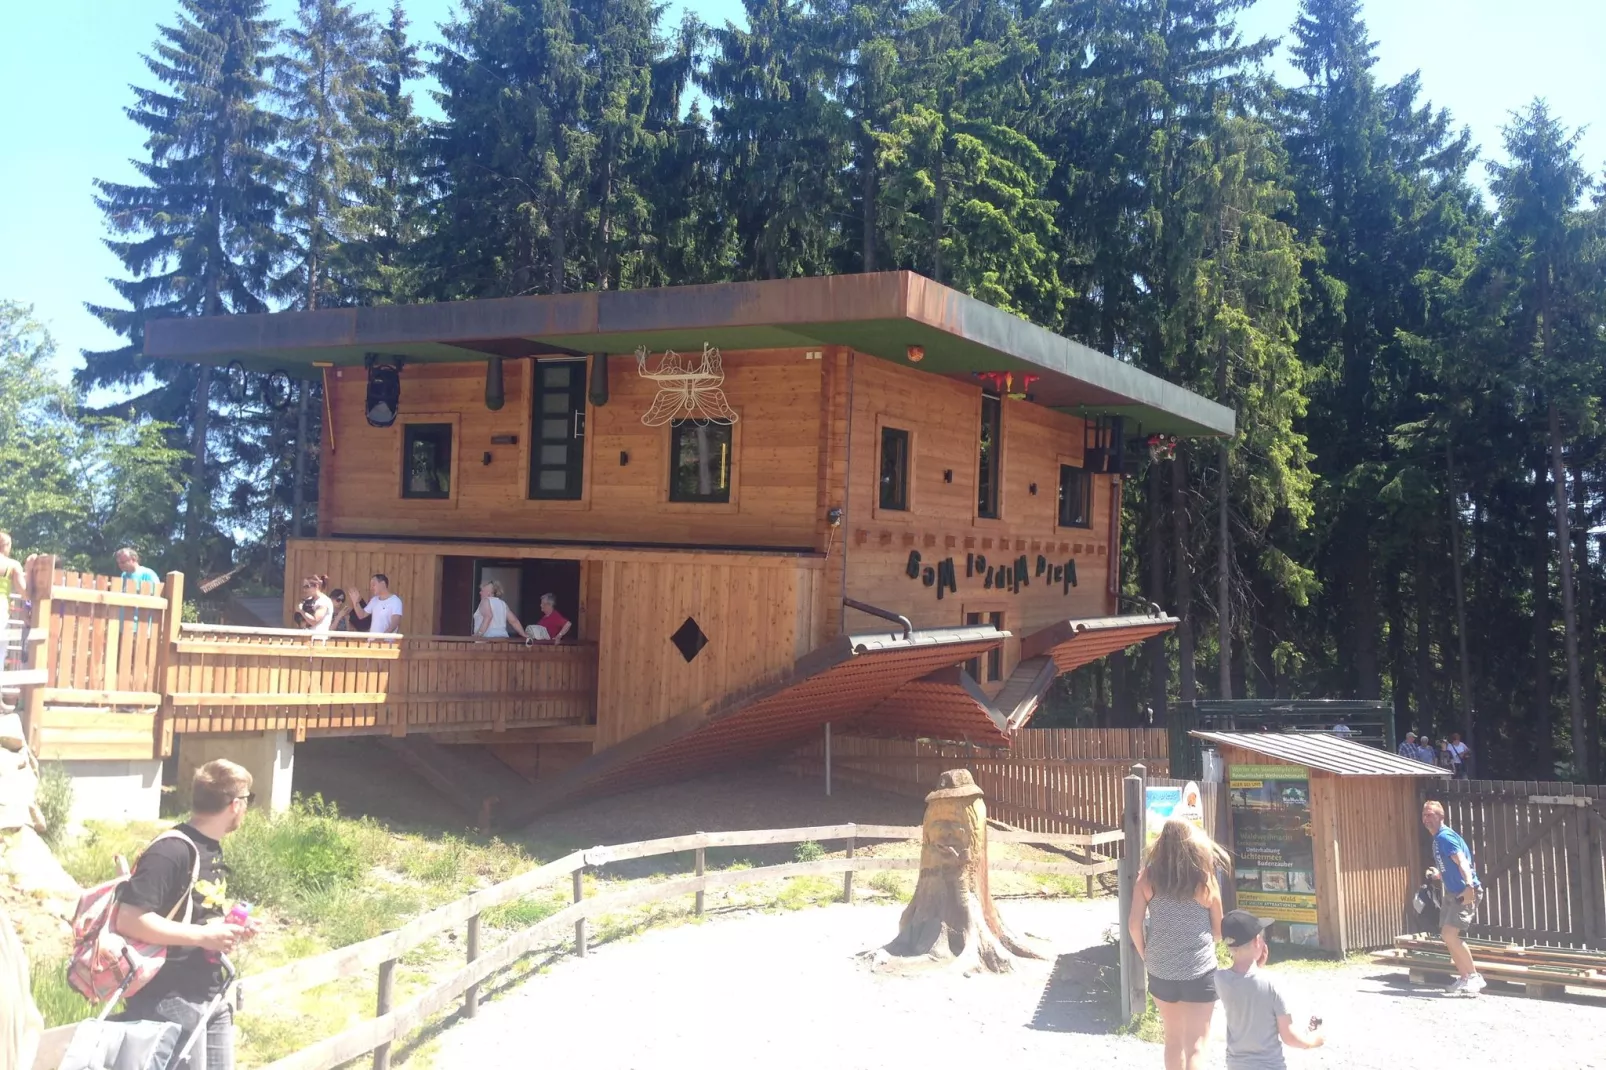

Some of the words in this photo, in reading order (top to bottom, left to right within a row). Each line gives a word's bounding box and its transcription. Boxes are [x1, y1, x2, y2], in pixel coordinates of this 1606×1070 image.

[906, 550, 957, 600] Weg
[967, 553, 1030, 594] Wipfel
[1036, 554, 1077, 596] Wald
[1241, 853, 1282, 861] Lichtermeer
[1246, 847, 1280, 855] Unterhaltung
